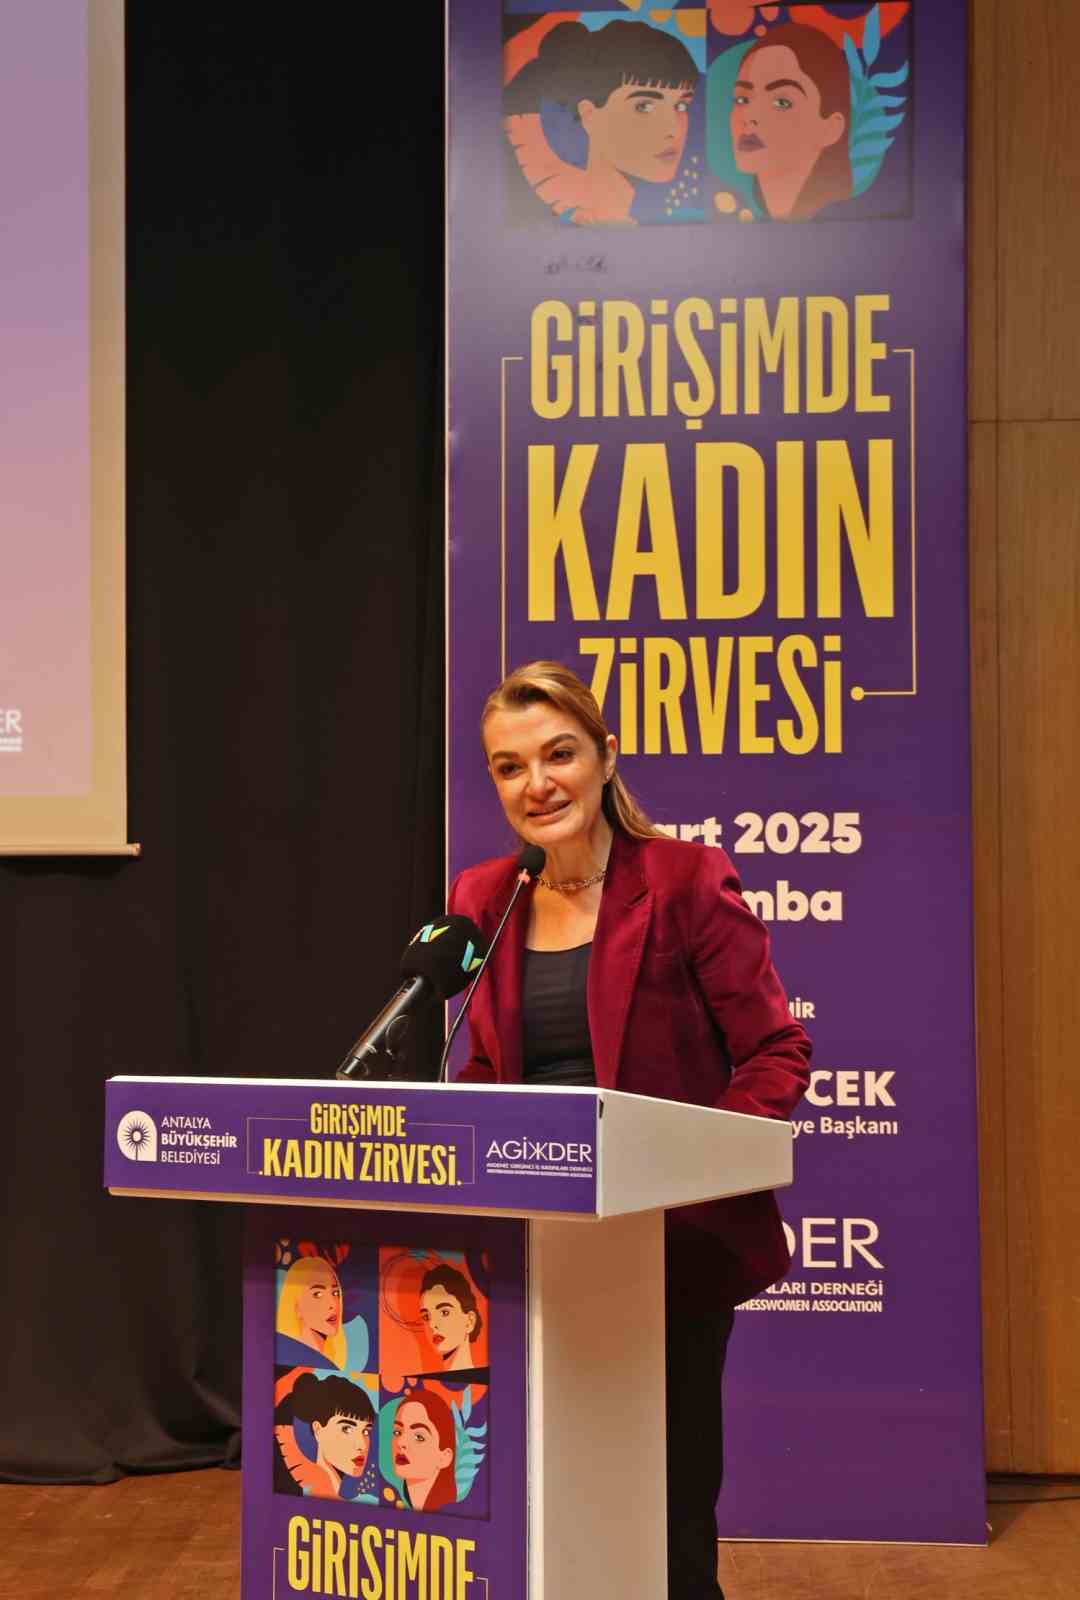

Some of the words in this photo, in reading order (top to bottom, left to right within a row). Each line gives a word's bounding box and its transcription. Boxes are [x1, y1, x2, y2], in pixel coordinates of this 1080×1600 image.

[527, 439, 895, 621] KADIN
[733, 811, 863, 855] 2025
[161, 1115, 213, 1130] ANTALYA
[820, 1116, 899, 1140] Başkanı
[161, 1131, 239, 1150] BÜYÜKŞEHİR
[161, 1148, 221, 1165] BELEDİYESİ
[811, 1280, 884, 1296] DERNEĞİ
[812, 1300, 883, 1313] ASSOCIATION
